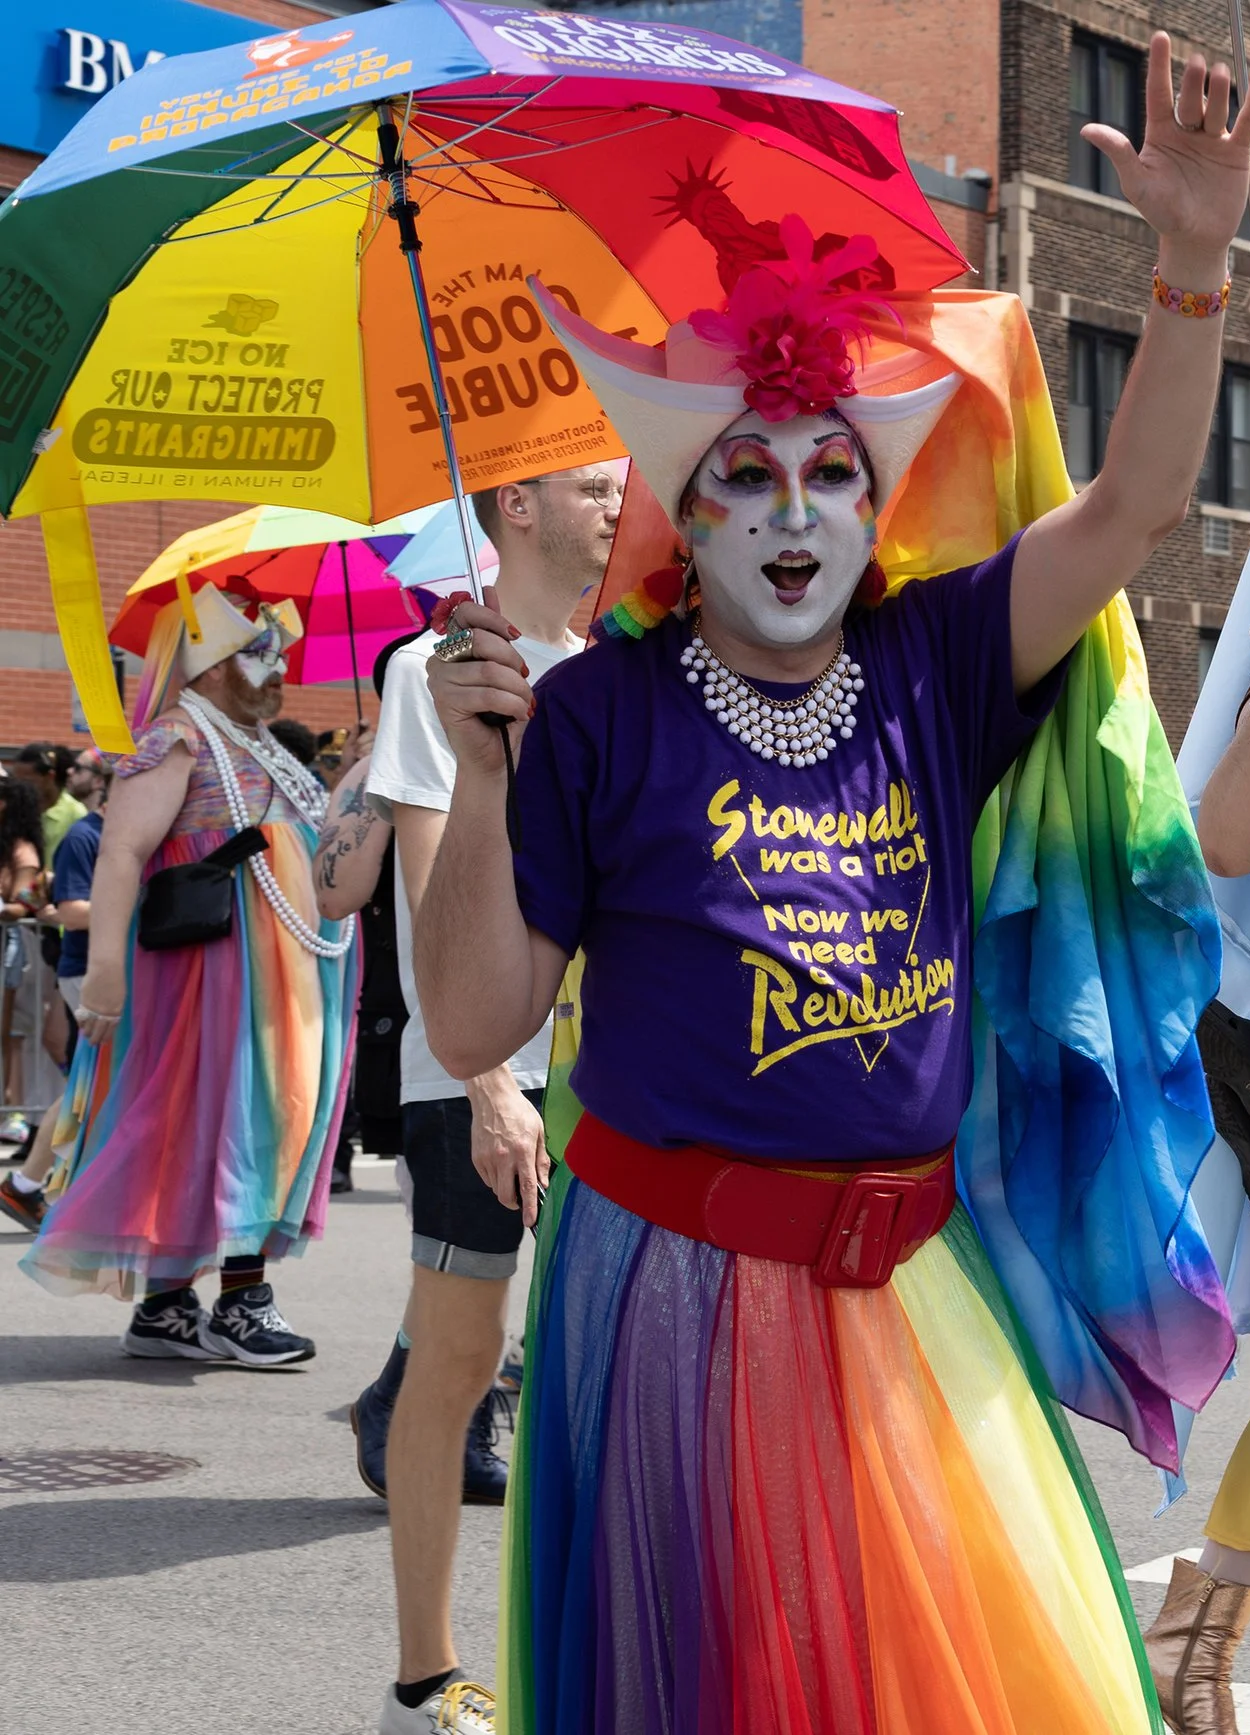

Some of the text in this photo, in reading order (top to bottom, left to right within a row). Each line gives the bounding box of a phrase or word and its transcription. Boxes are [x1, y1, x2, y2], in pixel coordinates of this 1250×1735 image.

[160, 47, 379, 109] YOU ARE NOT
[492, 24, 788, 78] OLIGARCHS
[107, 60, 414, 154] PROPAGANDA
[139, 53, 389, 131] IMMUNE TO
[707, 778, 918, 861] Stonewall
[760, 834, 928, 876] was a riot
[763, 904, 909, 933] Now we
[788, 937, 877, 965] need
[809, 967, 836, 985] a
[741, 949, 954, 1055] Revolution
